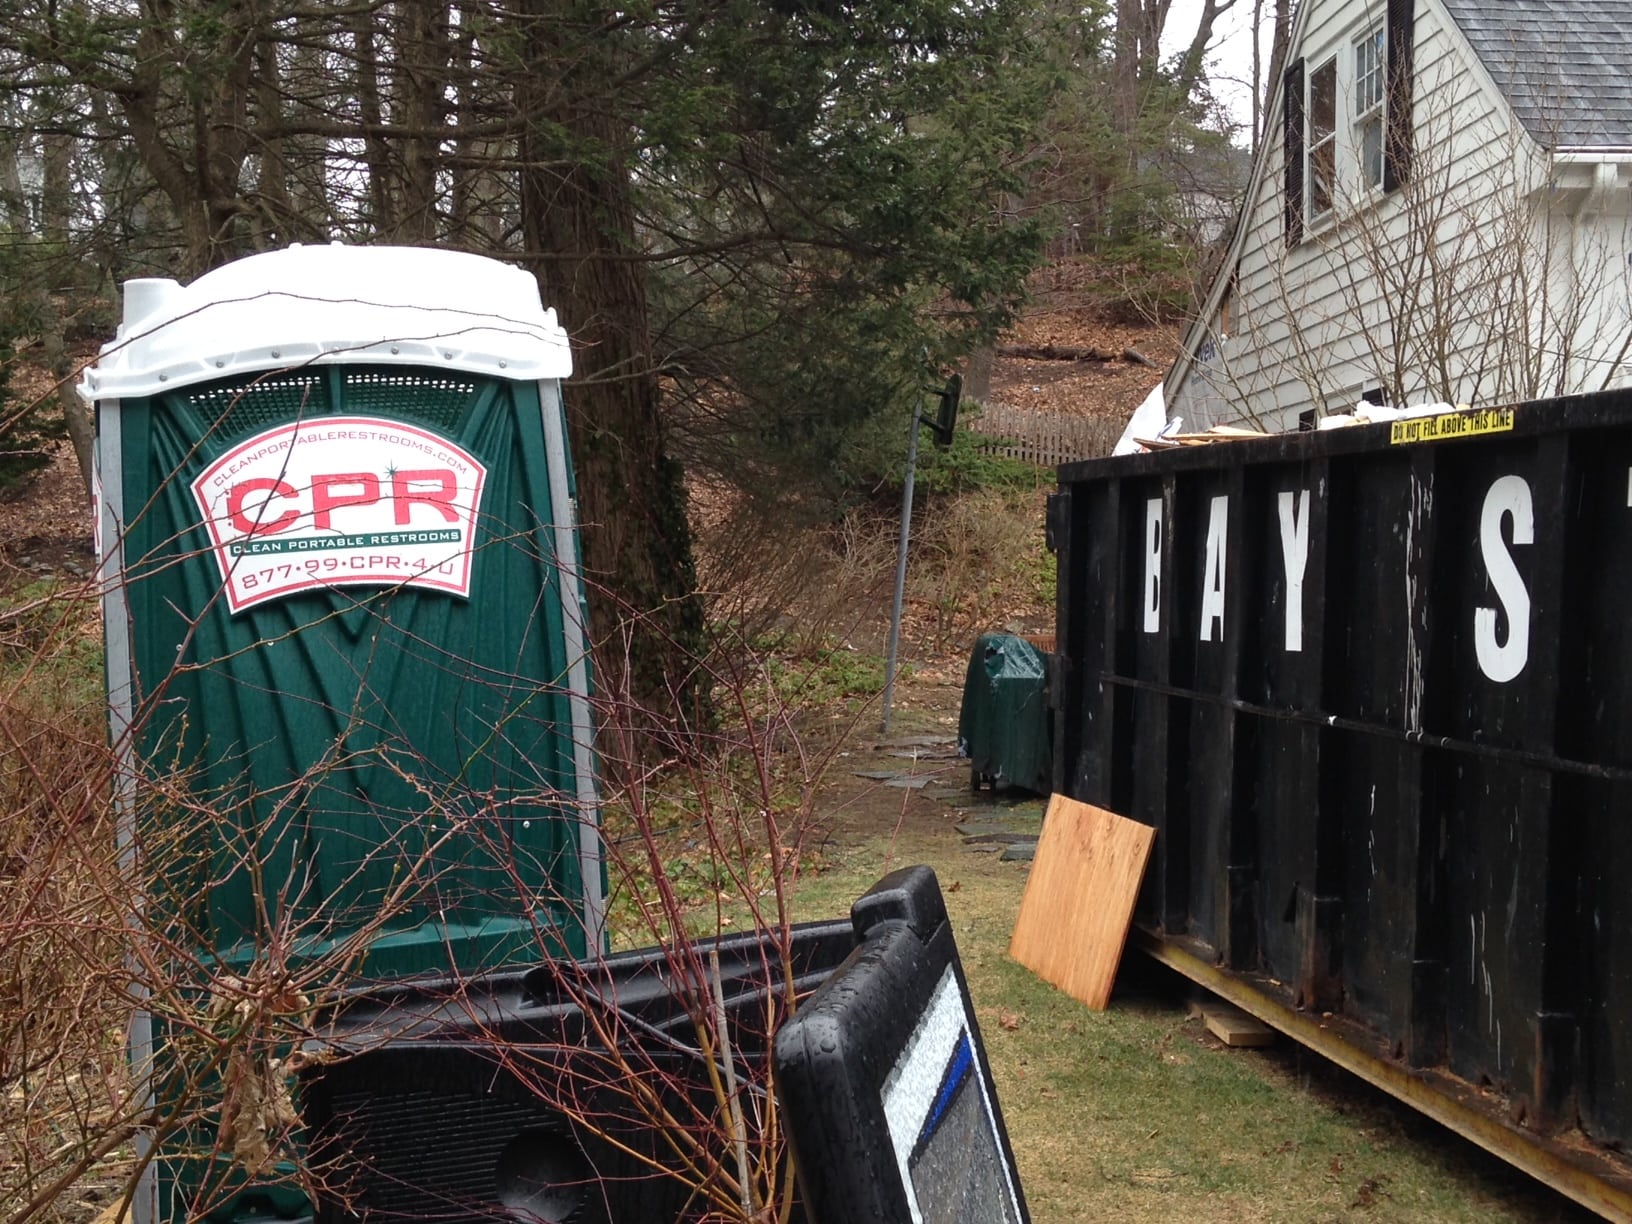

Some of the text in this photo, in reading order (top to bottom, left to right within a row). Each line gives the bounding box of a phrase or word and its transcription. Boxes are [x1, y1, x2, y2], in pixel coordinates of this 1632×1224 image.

[1393, 409, 1510, 441] DO NOT FILL ABOVE THIS LINE
[213, 431, 467, 487] CLEANPORTABLERESTROOMS.COM
[226, 469, 459, 535] CPR
[233, 531, 460, 554] CLEAN PORTABLE RESTROOMS
[1144, 490, 1310, 652] BAY
